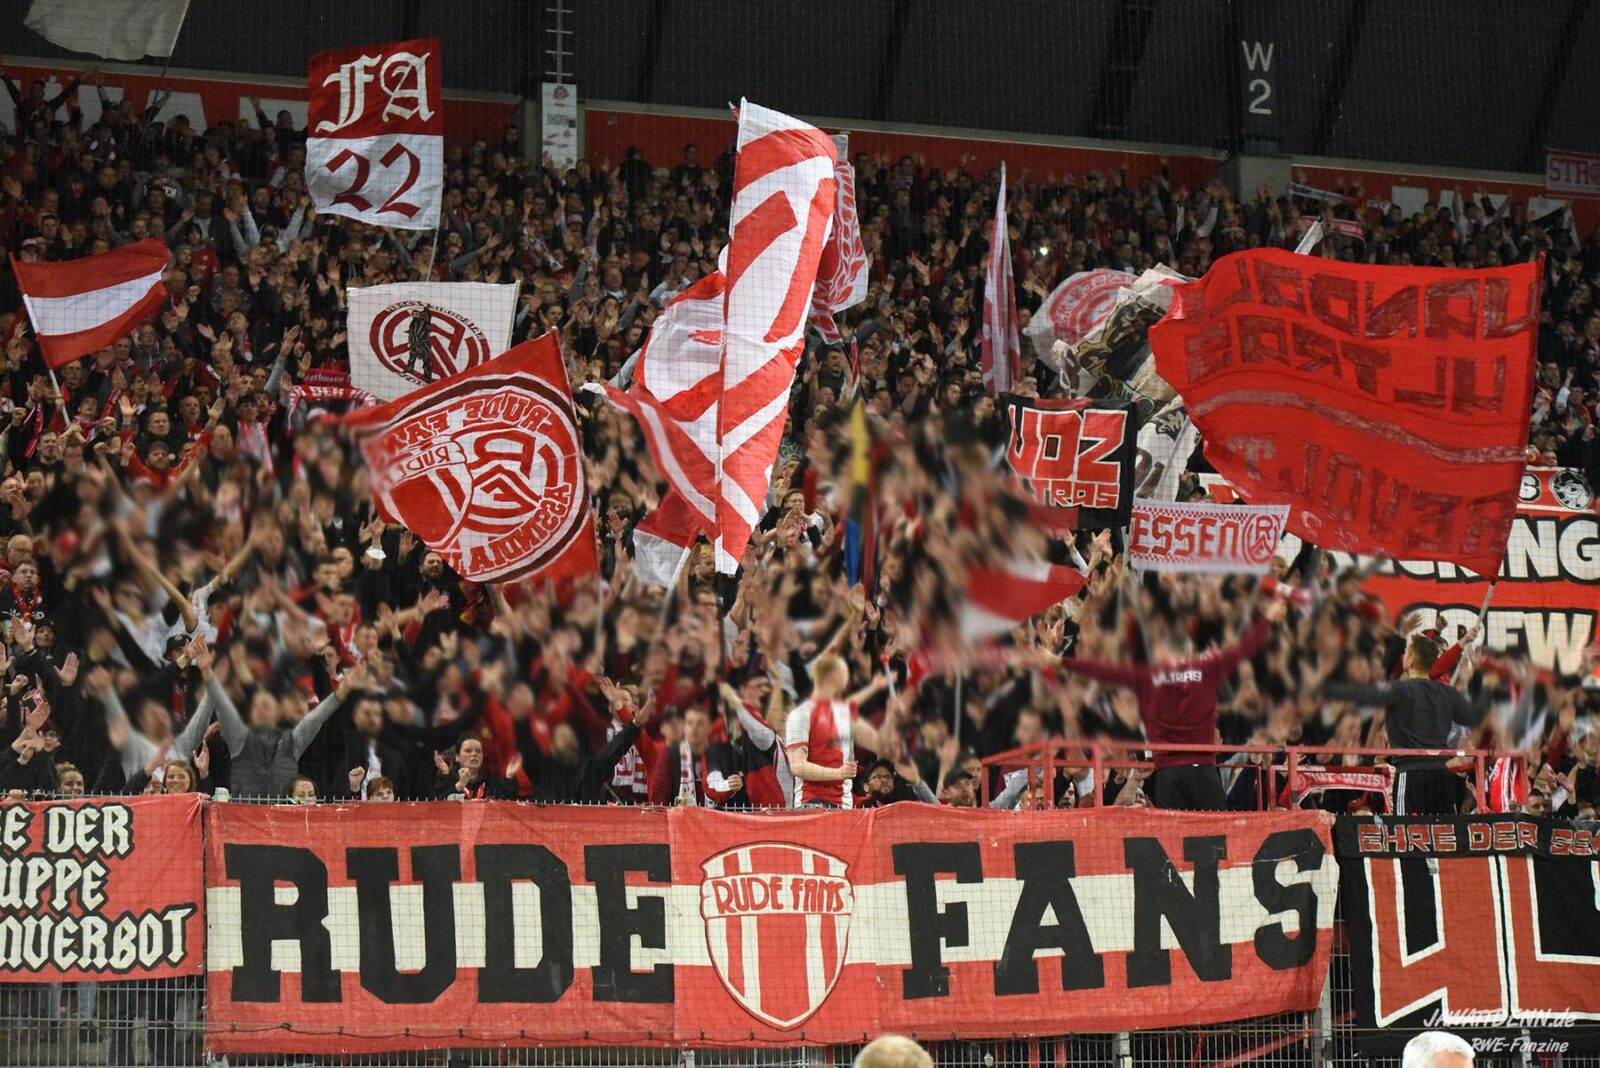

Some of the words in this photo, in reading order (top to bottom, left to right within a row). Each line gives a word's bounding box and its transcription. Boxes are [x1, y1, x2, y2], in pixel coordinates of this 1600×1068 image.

[1241, 41, 1274, 72] W
[1248, 79, 1273, 115] 2
[325, 141, 422, 219] 22
[1129, 511, 1241, 557] ESSEN
[0, 804, 32, 853] E
[45, 803, 132, 857] DER
[1357, 822, 1457, 852] EHRE
[1467, 821, 1539, 850] DER
[223, 842, 675, 1004] RUDE
[891, 827, 1326, 1000] FANS
[711, 876, 784, 915] RUDE
[790, 878, 846, 913] FANS
[1364, 854, 1600, 1027] UL
